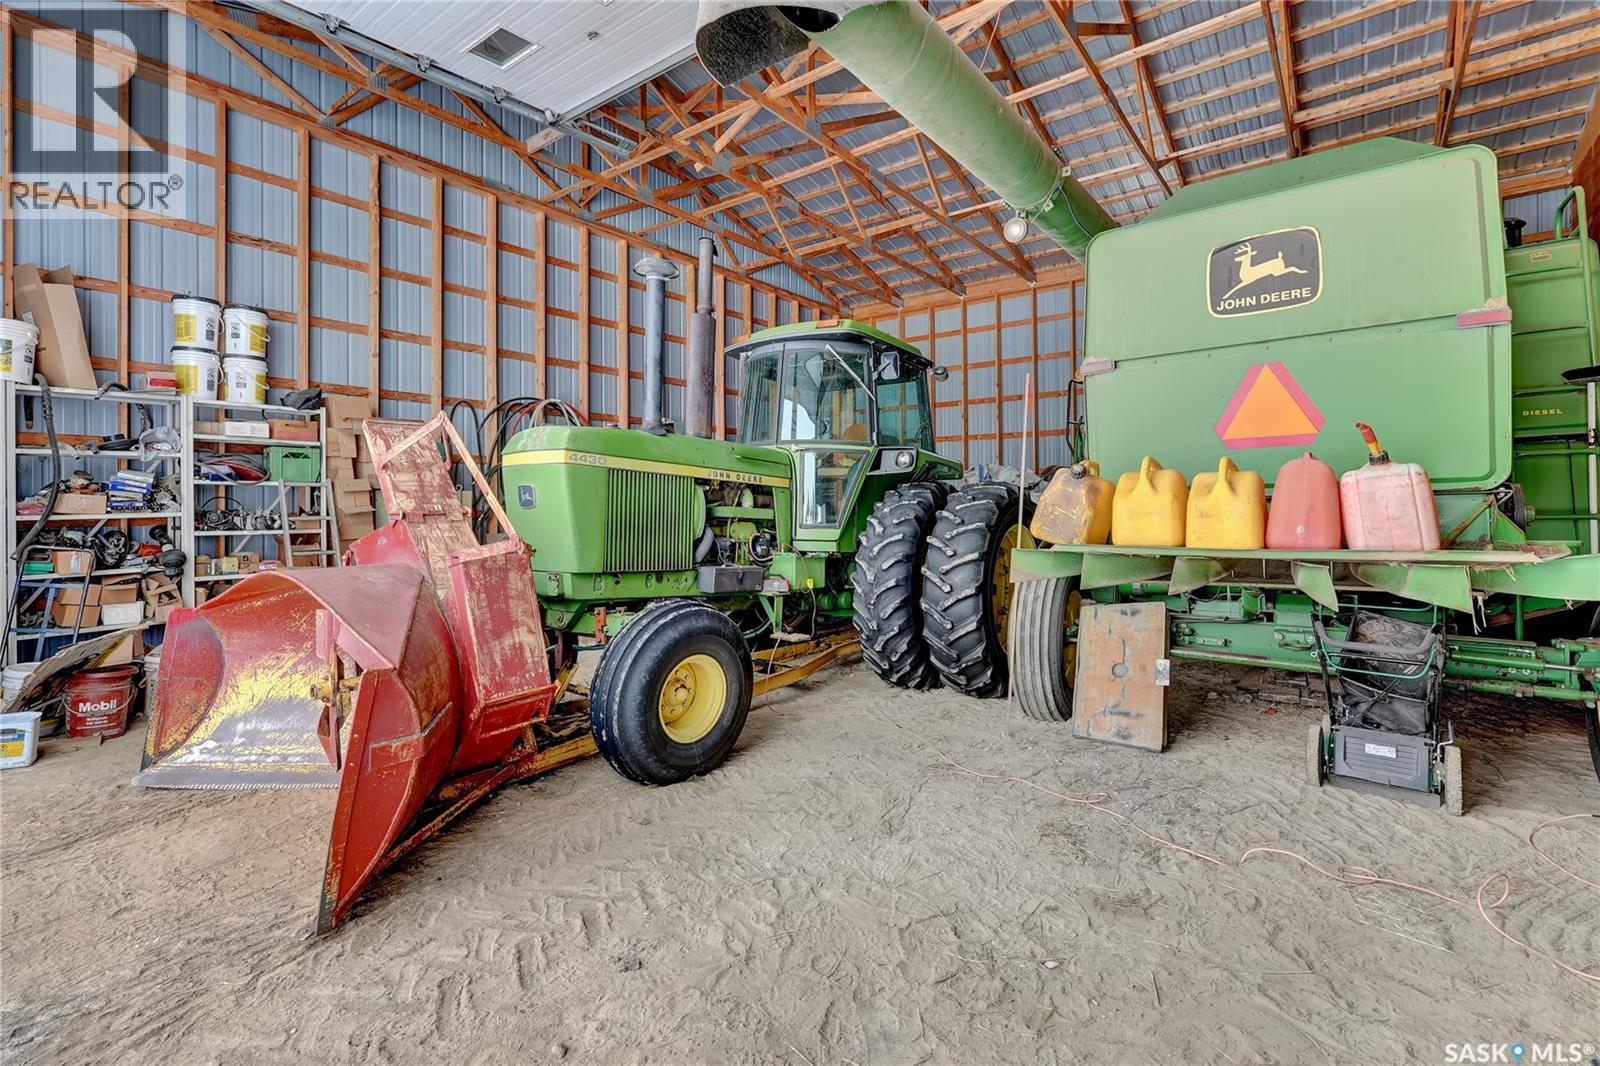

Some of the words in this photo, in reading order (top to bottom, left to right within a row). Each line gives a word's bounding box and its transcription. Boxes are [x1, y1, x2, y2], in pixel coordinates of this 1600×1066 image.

[1216, 295, 1257, 311] JOHN
[1260, 287, 1312, 304] DEERE
[1522, 408, 1563, 416] DIESEL
[569, 453, 608, 465] 4430
[736, 473, 762, 483] DEERE
[78, 699, 117, 713] Mobil
